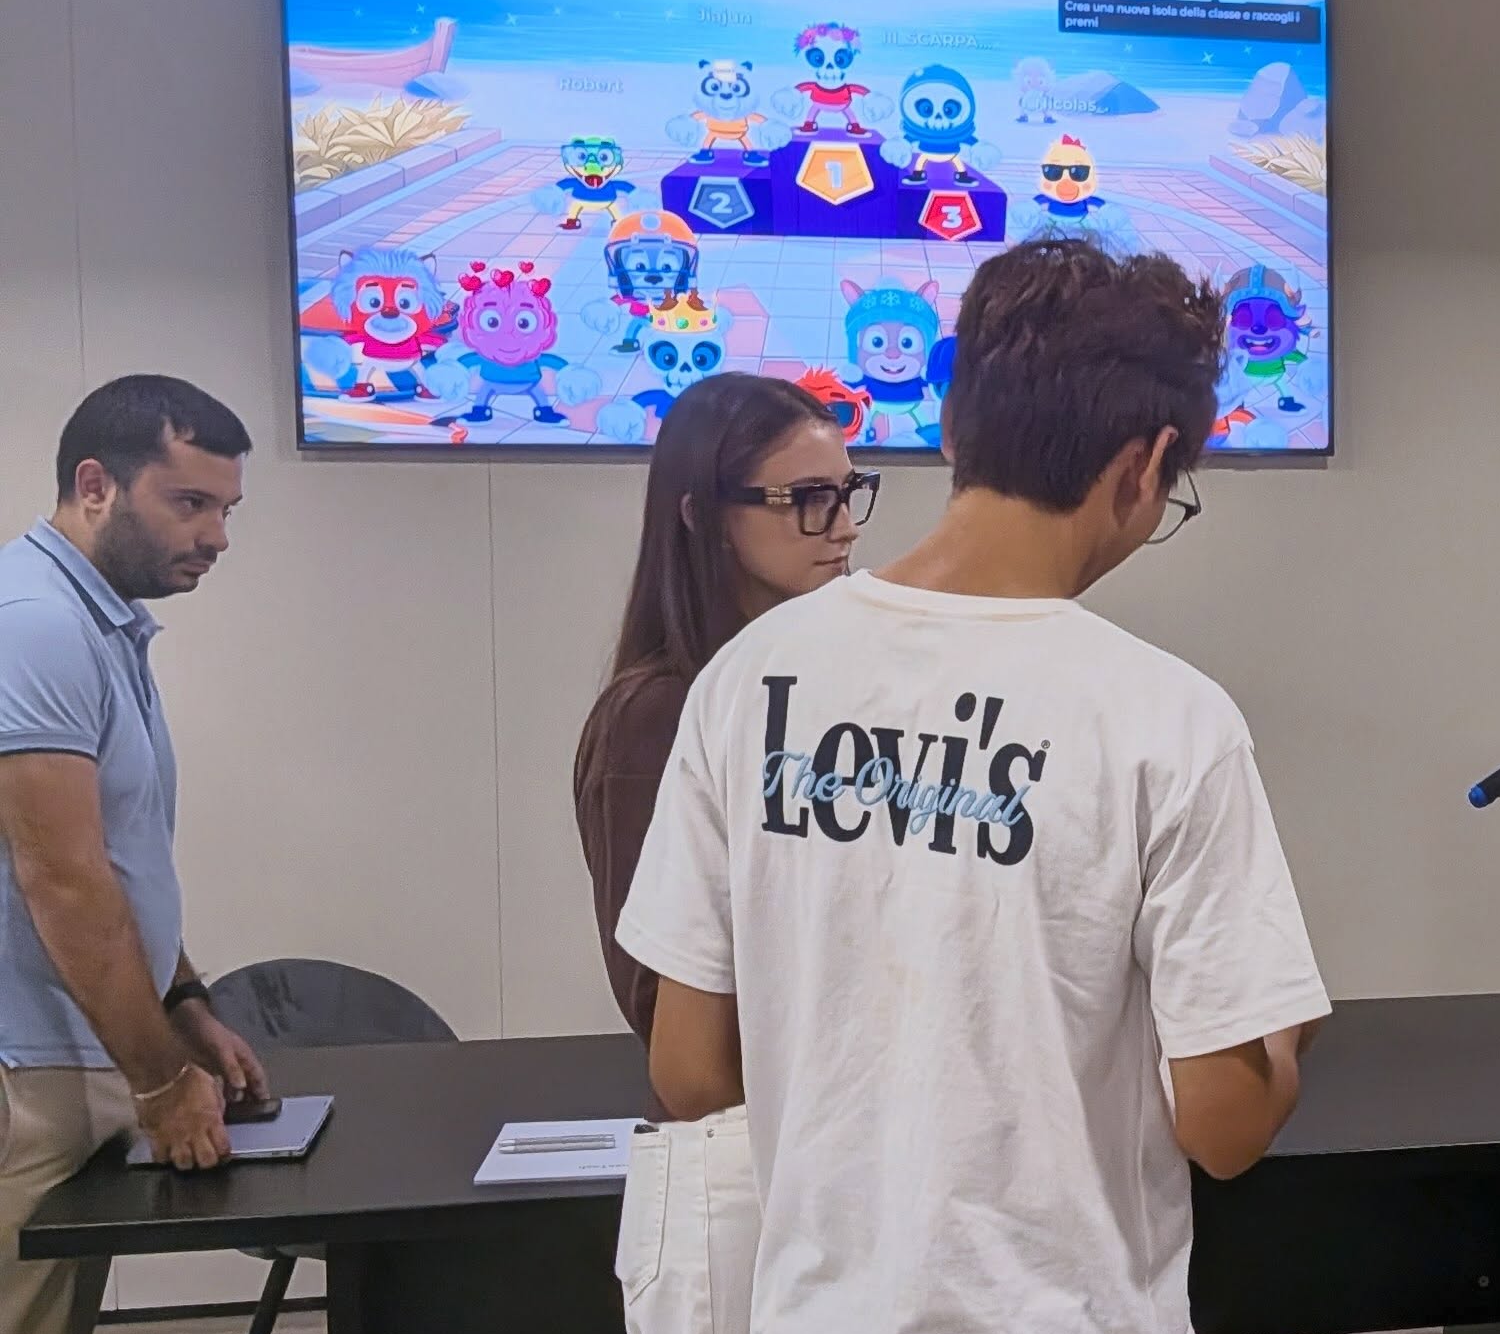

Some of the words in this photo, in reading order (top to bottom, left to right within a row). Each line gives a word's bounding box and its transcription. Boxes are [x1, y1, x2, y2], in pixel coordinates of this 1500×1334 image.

[1064, 0, 1092, 13] Crea
[1093, 3, 1115, 14] una
[1117, 5, 1151, 17] nuova
[1153, 4, 1178, 17] isola
[1179, 5, 1207, 19] della
[1208, 7, 1242, 21] classe
[1252, 9, 1295, 25] raccogli
[1065, 15, 1100, 30] premi
[824, 161, 844, 189] 1
[707, 191, 733, 214] 2
[941, 205, 964, 229] 3
[761, 675, 1048, 866] Levi's
[761, 750, 846, 803] The
[854, 755, 1032, 836] Original
